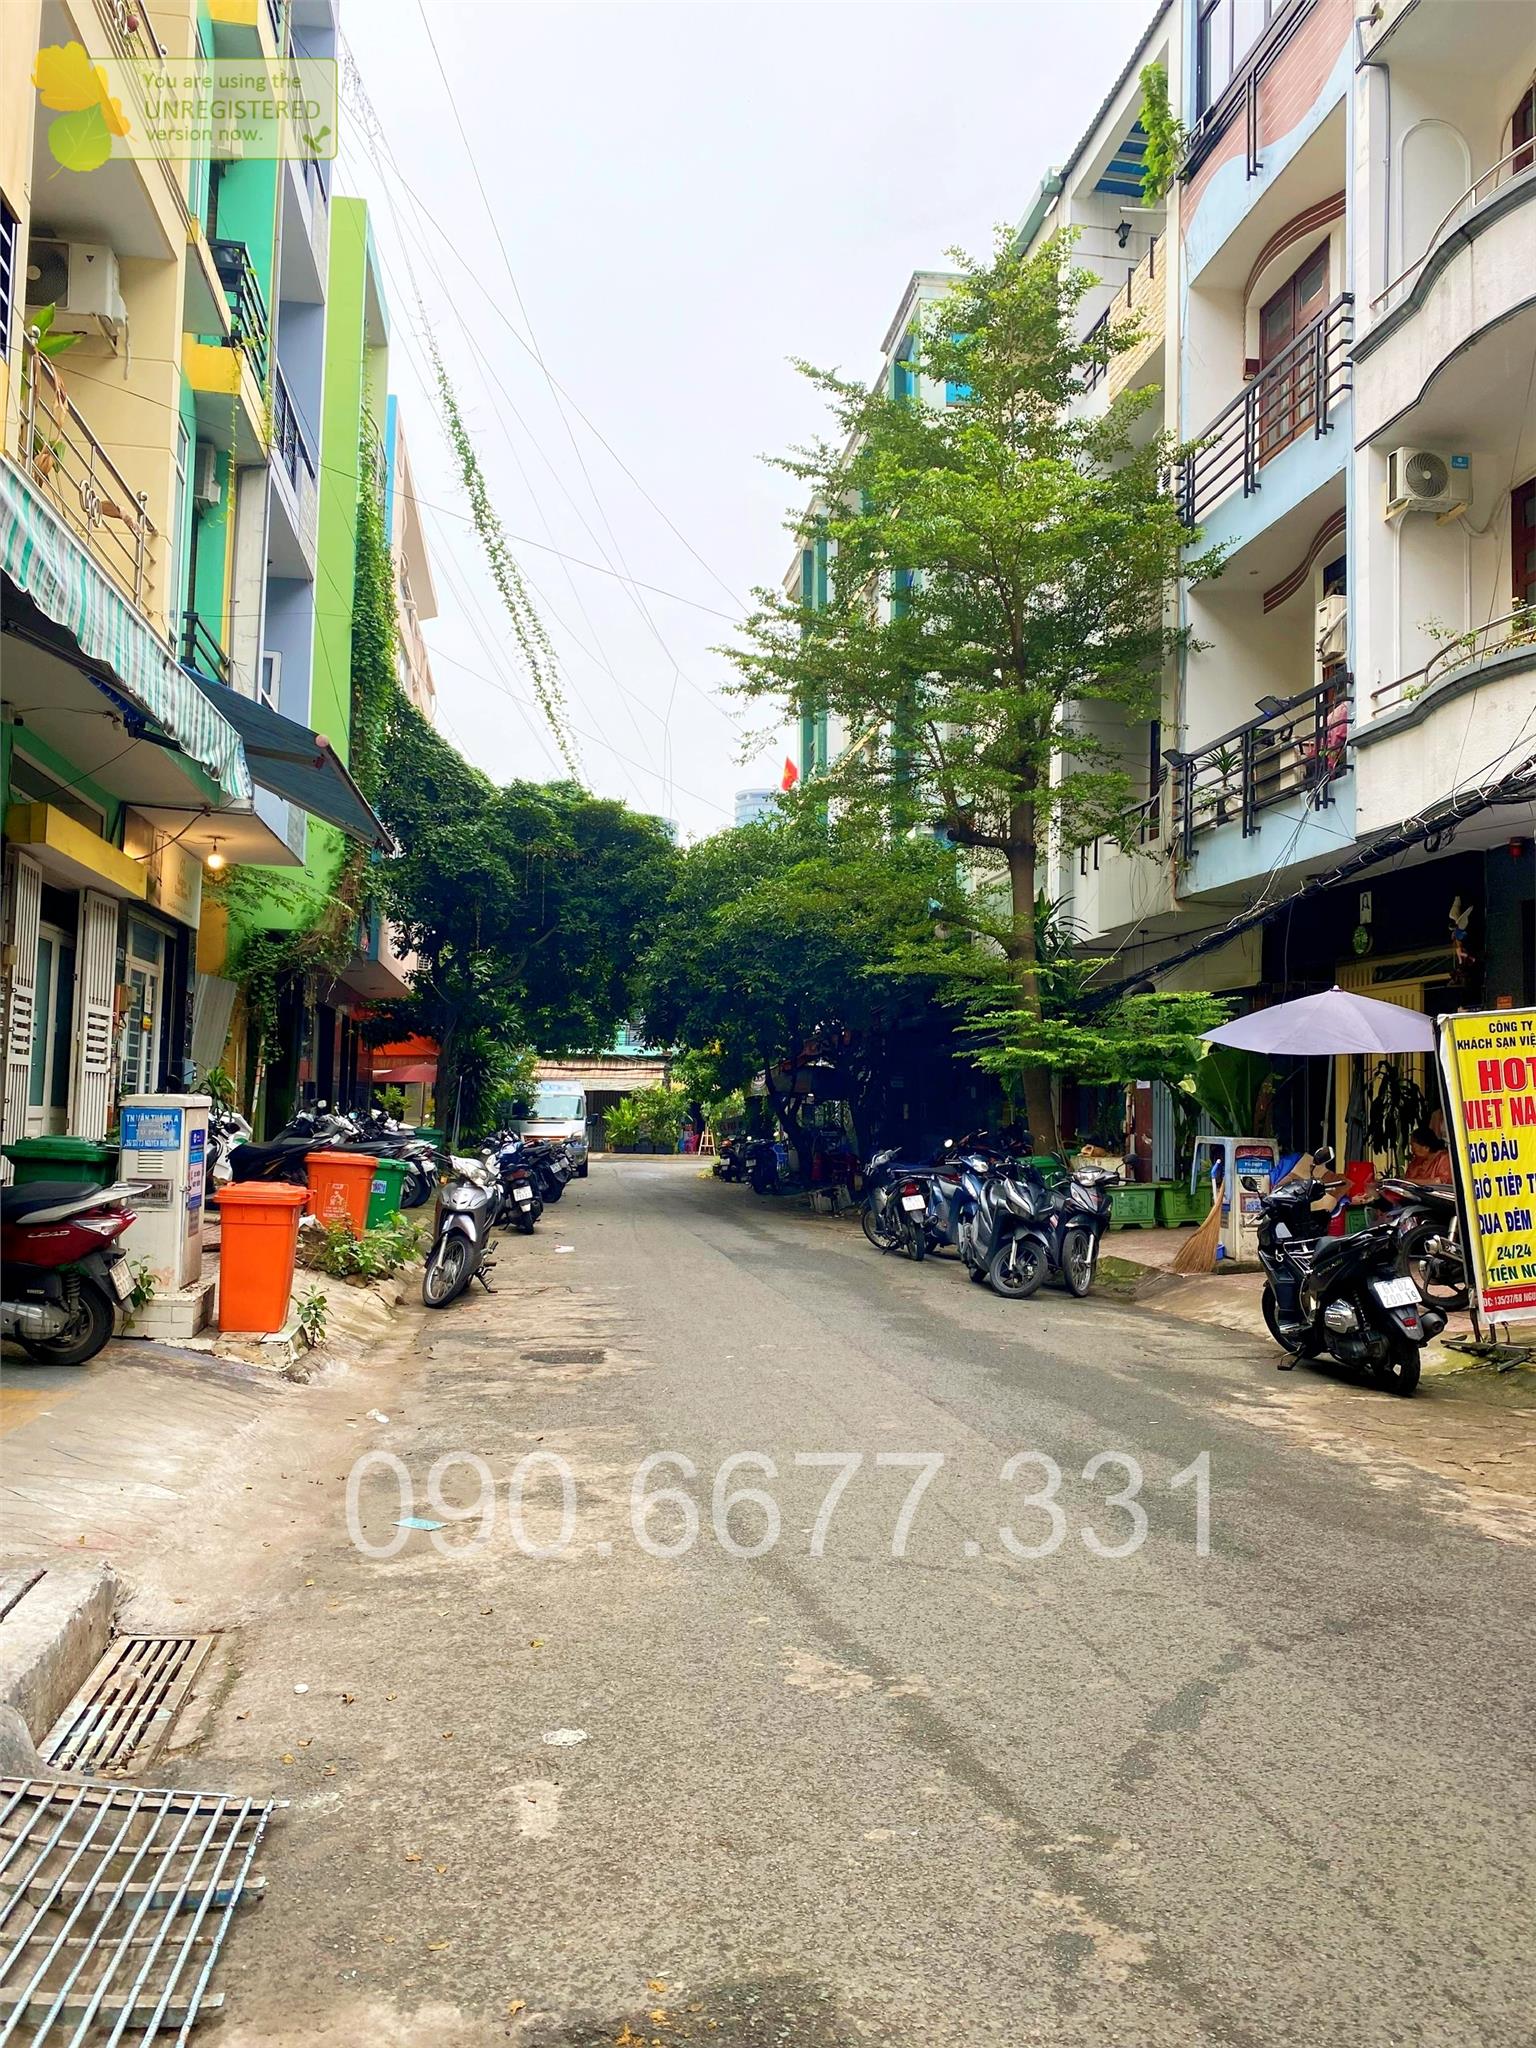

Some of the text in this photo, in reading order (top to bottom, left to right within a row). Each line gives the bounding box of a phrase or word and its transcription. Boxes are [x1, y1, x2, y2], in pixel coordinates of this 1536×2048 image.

[1489, 1020, 1533, 1033] CÔNG TY
[1457, 1037, 1492, 1050] KHÁCH
[1496, 1037, 1516, 1049] SẠN
[1491, 1133, 1518, 1161] ĐẦU
[1496, 1168, 1522, 1196] TIẾP
[1505, 1207, 1532, 1232] ĐÊM
[1497, 1244, 1531, 1260] 24/24
[1489, 1264, 1519, 1284] TIỆN
